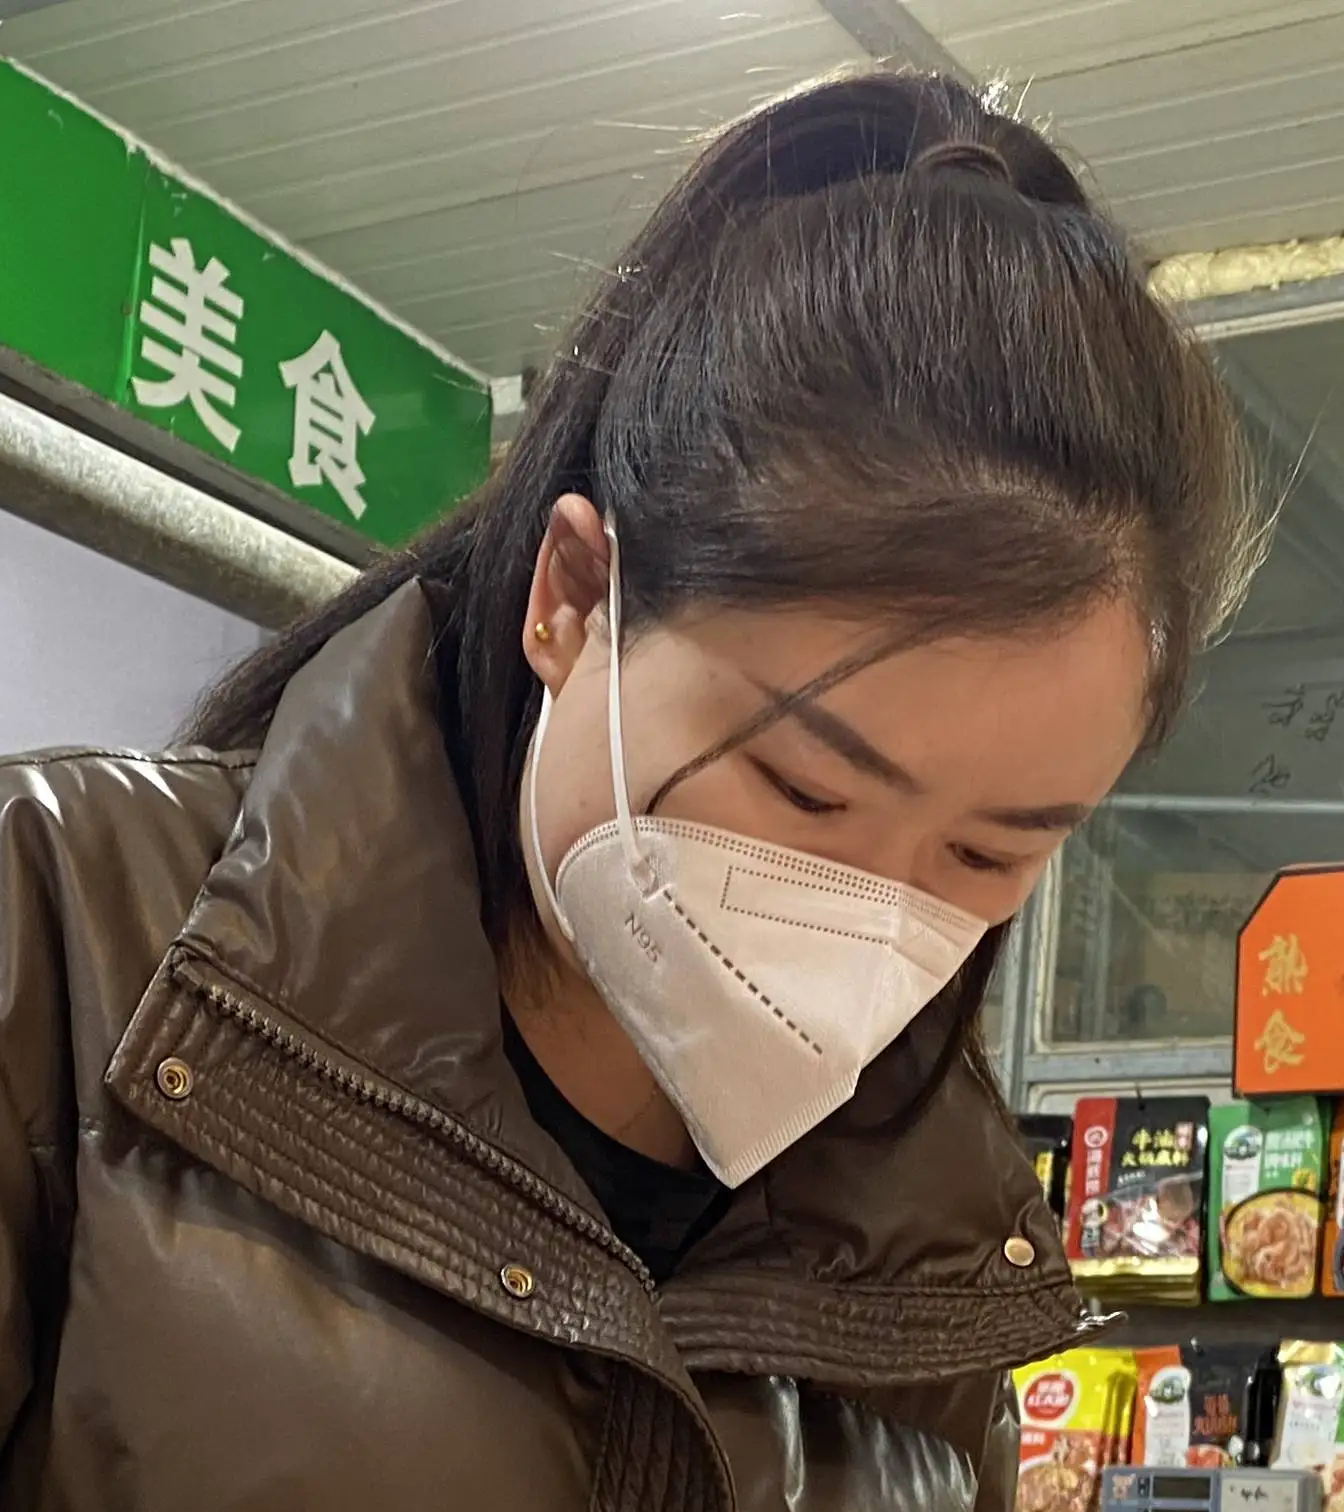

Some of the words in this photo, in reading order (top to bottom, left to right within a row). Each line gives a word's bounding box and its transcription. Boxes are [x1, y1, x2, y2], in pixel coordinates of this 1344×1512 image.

[131, 238, 378, 520] 美食
[624, 911, 663, 964] N95
[1254, 932, 1309, 1076] 熟食
